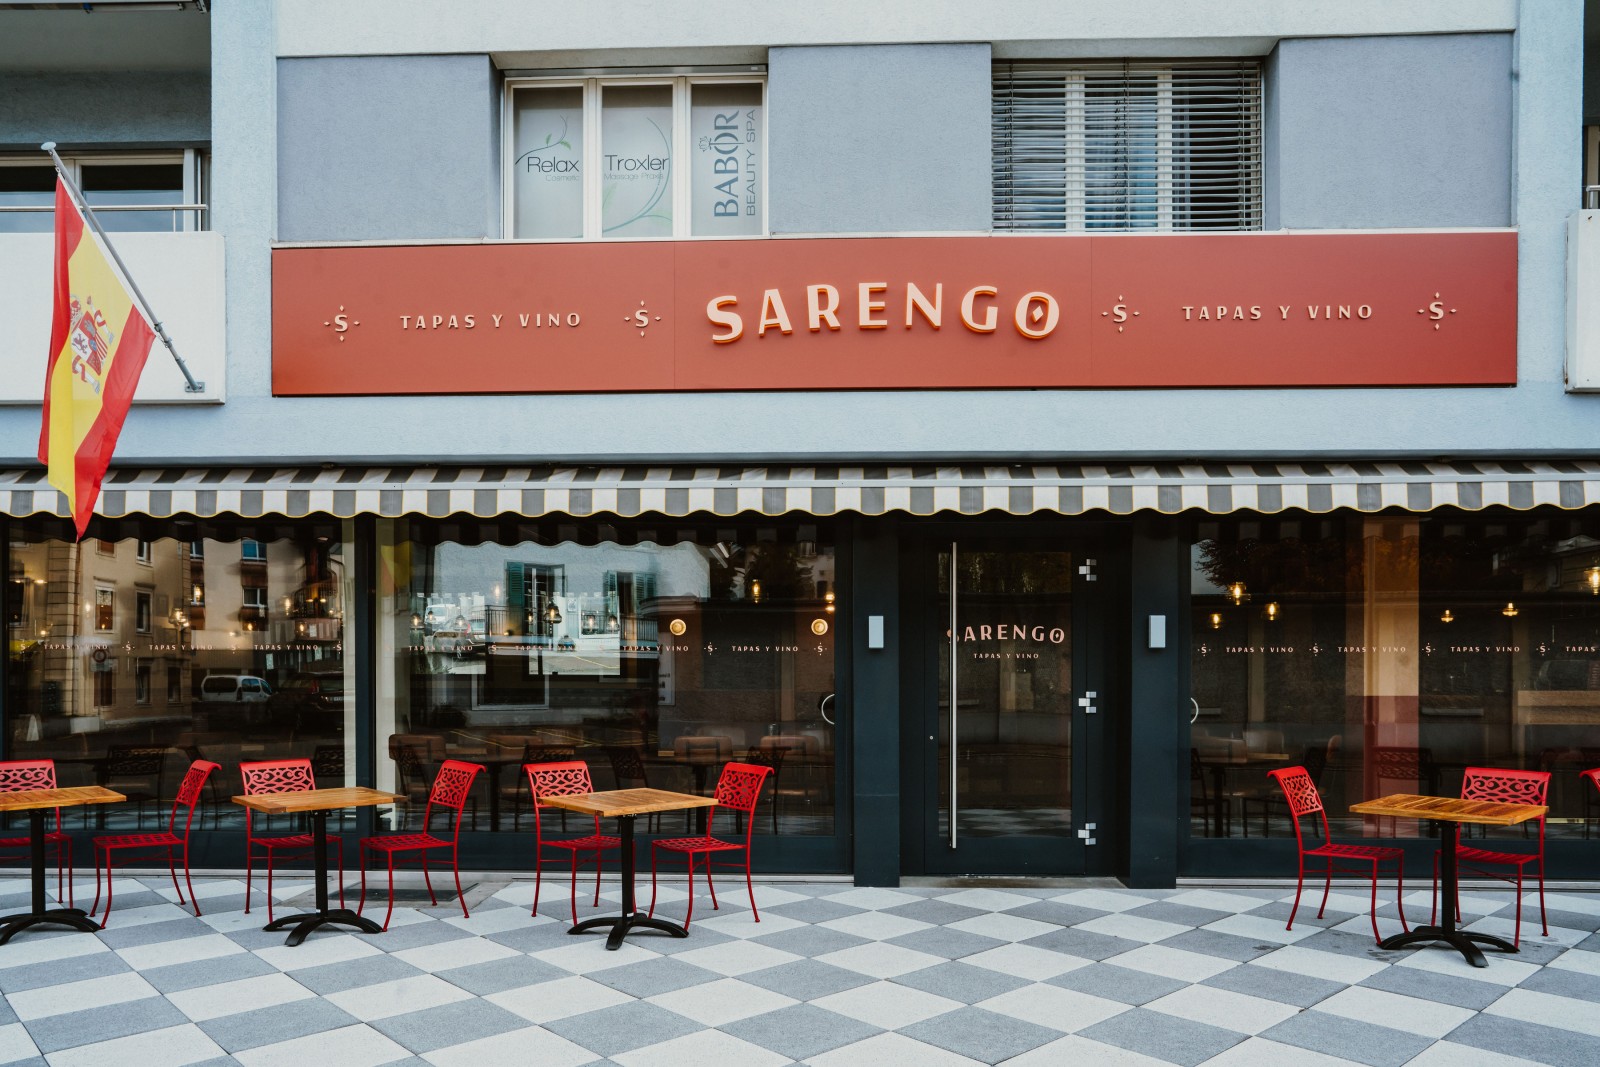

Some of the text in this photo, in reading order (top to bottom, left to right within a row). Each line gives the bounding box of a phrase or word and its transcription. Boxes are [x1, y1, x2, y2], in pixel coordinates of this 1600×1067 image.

[527, 156, 580, 173] Relax
[604, 154, 670, 171] Troxler
[713, 109, 740, 217] BABOR
[746, 109, 756, 216] BEAUTY SPA
[545, 174, 580, 182] Cosmetic
[604, 173, 639, 181] Massage
[400, 312, 581, 330] TAPAS Y VINO
[706, 282, 1060, 344] SARENGO
[1182, 304, 1373, 321] TAPAS Y VINO
